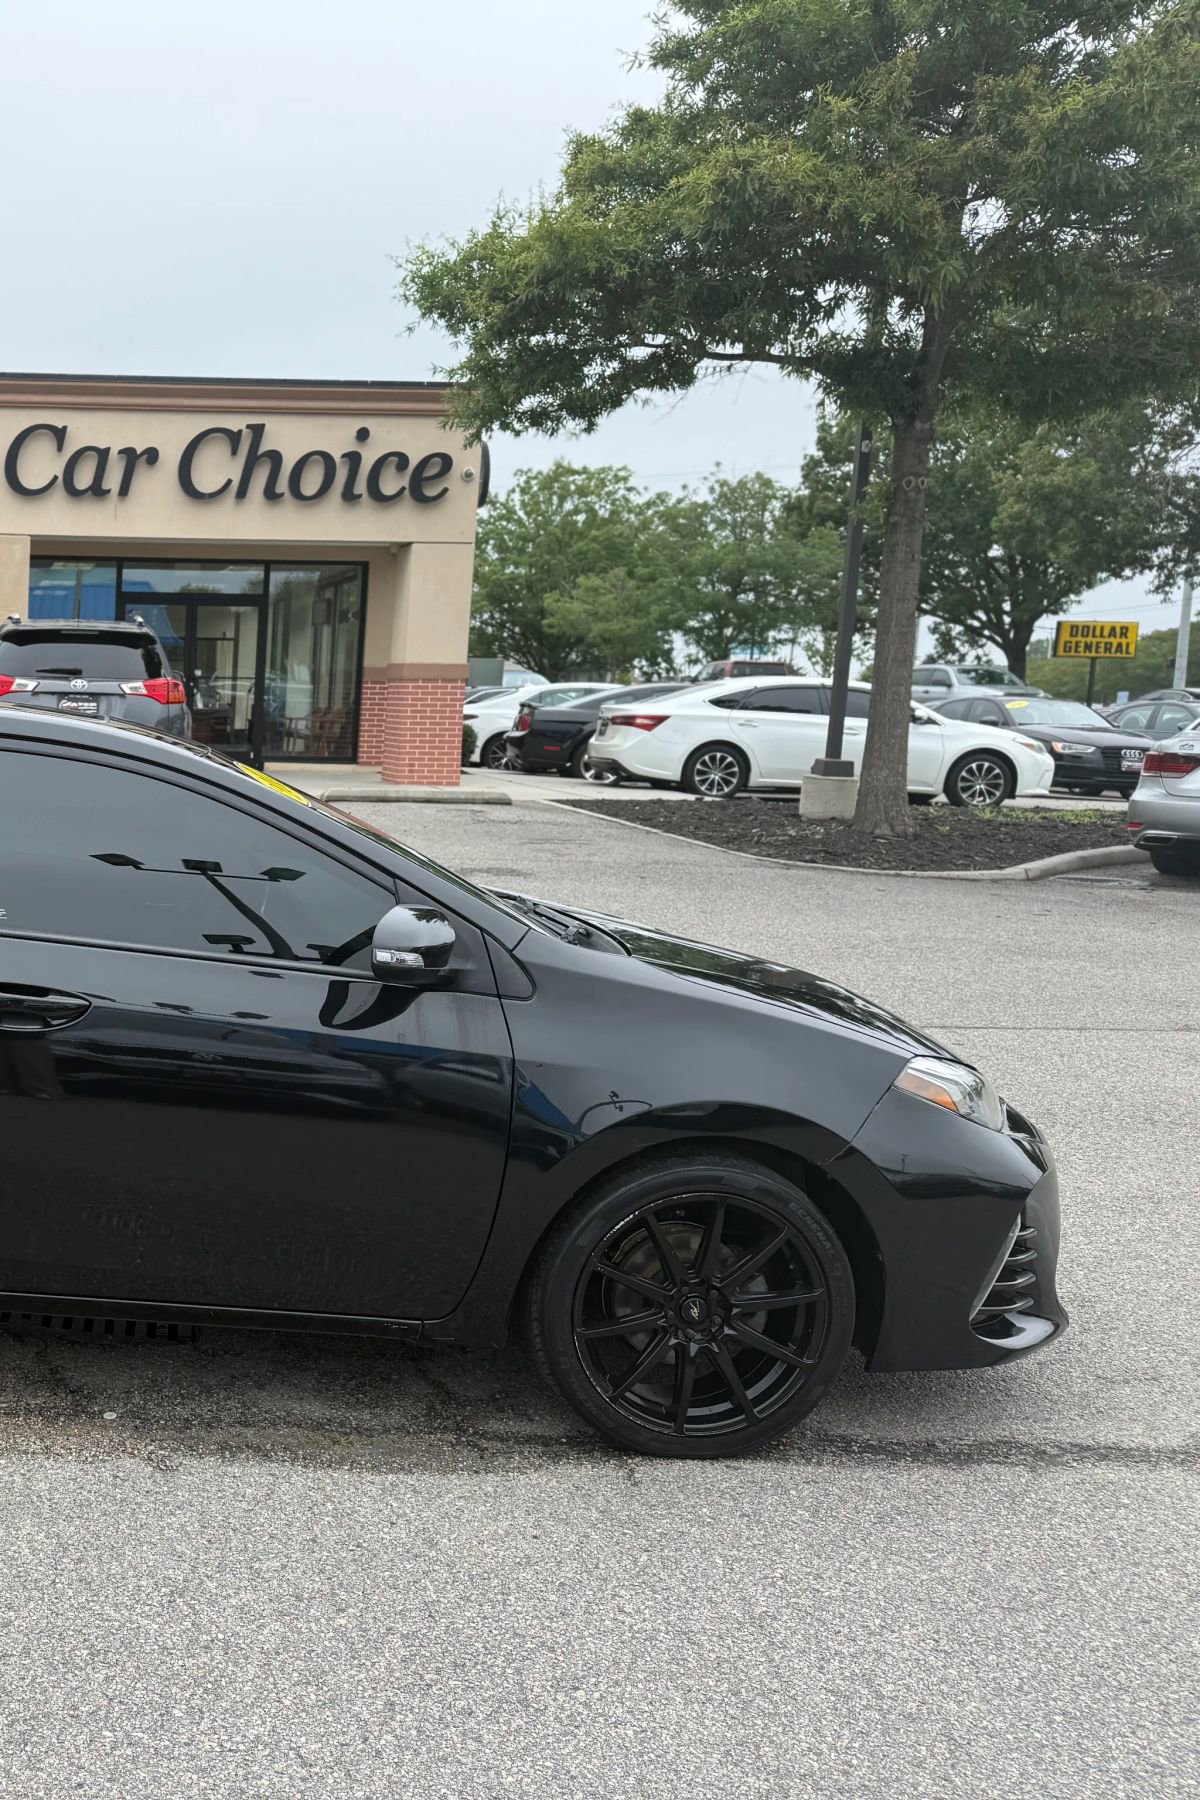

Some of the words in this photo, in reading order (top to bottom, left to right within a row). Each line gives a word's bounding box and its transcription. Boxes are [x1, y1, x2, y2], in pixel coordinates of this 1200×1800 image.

[3, 423, 160, 498] Car
[177, 422, 454, 503] Choice
[1069, 624, 1130, 639] DOLLAR
[1063, 640, 1133, 655] GENERAL
